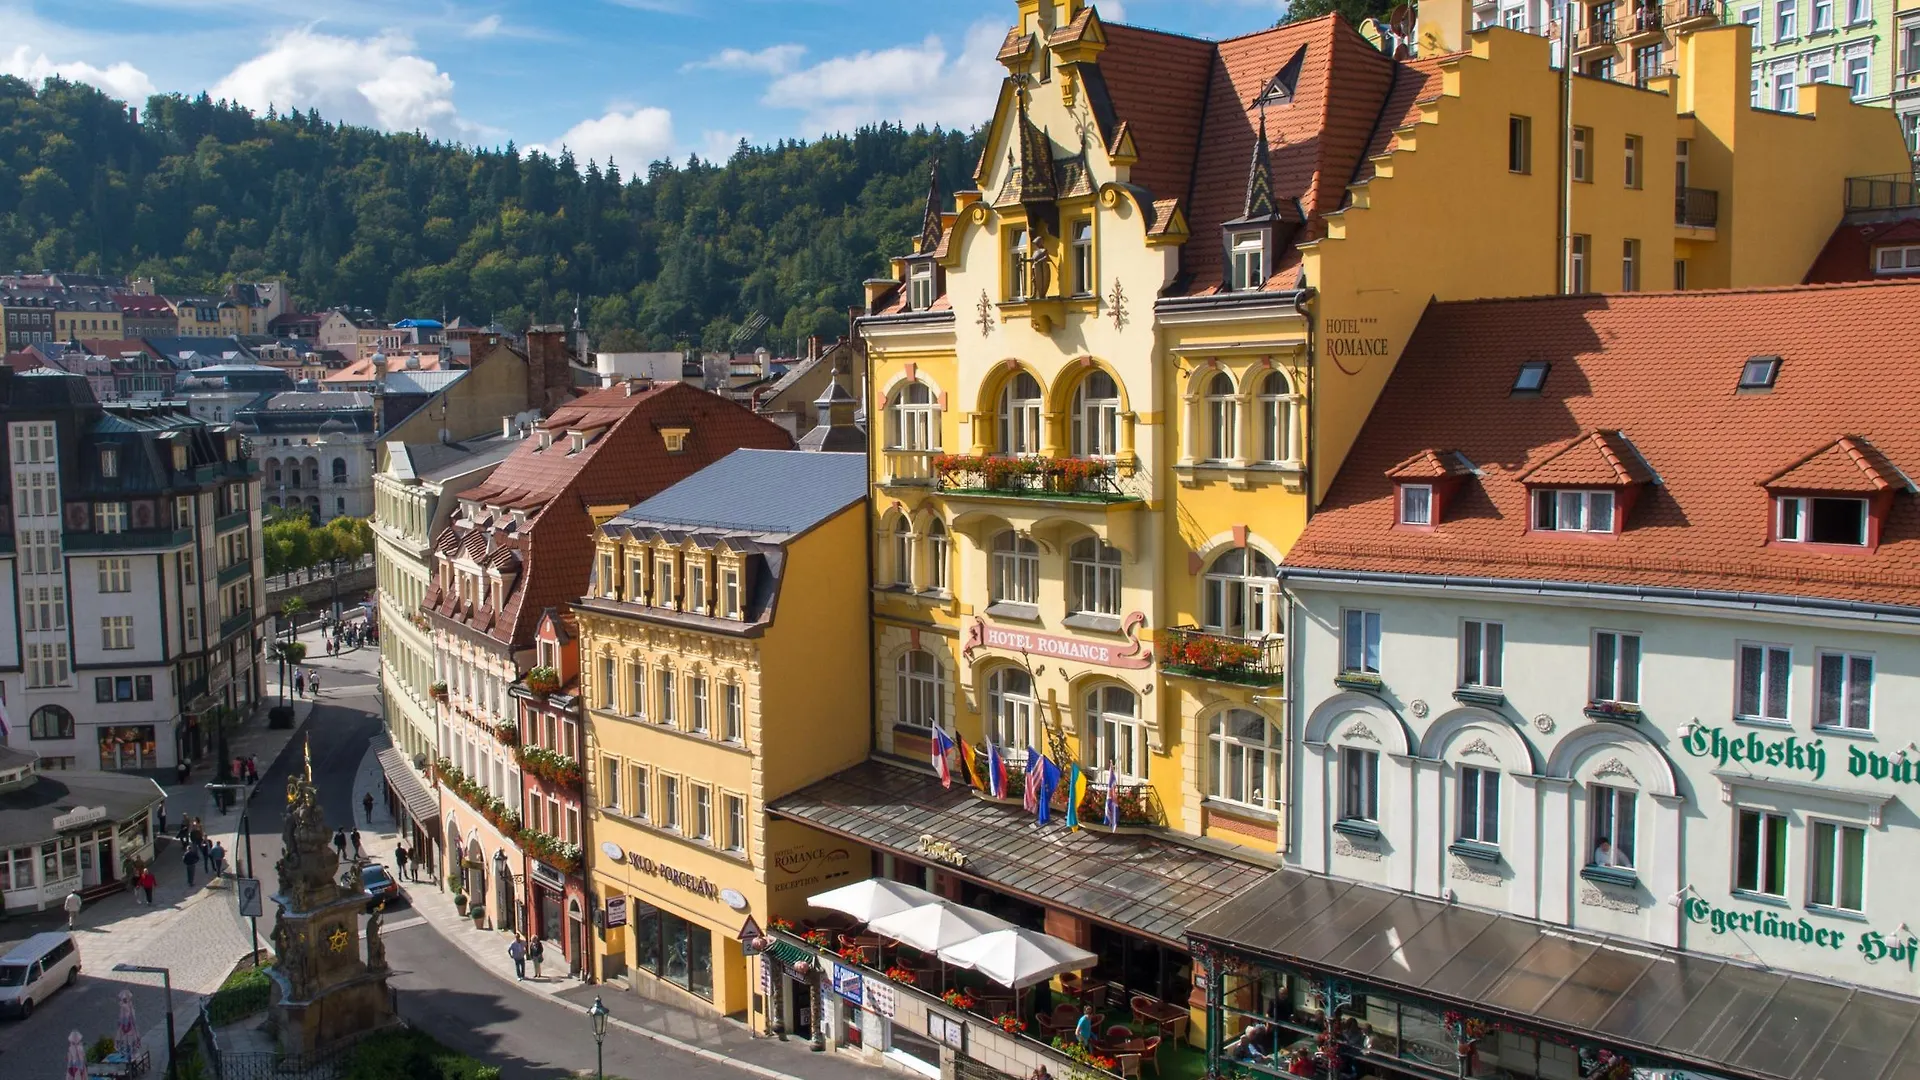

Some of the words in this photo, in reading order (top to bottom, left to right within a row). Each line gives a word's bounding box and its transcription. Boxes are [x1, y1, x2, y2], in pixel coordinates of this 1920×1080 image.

[1326, 318, 1360, 334] HOTEL
[1326, 338, 1388, 356] ROMANCE
[988, 629, 1034, 649] HOTEL
[1037, 636, 1110, 662] ROMANCE
[1681, 724, 1827, 782] Chebský
[774, 848, 826, 868] ROMANCE
[775, 876, 820, 892] RECEPTION
[1684, 896, 1845, 950] Egerländer
[1857, 931, 1918, 973] Hof
